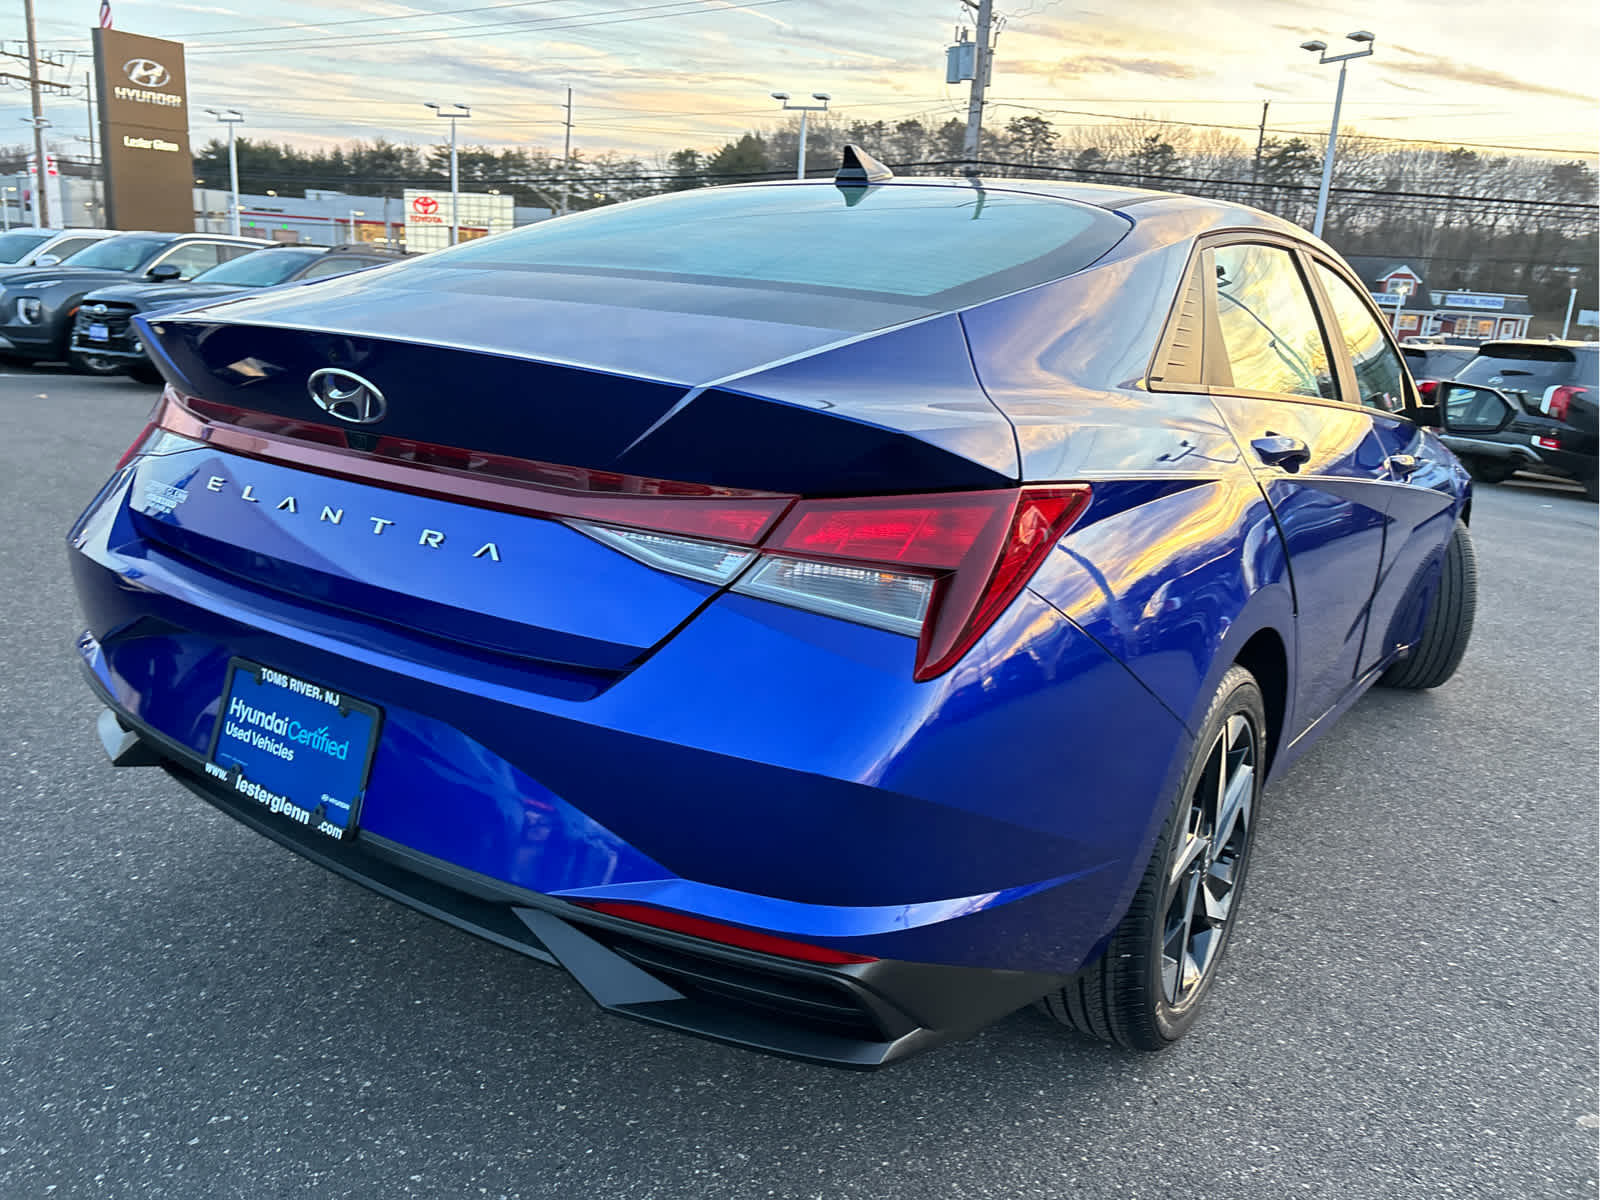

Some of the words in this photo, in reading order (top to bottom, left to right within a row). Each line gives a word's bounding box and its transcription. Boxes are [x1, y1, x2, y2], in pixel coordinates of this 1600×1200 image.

[114, 87, 182, 107] HYUNDAI
[409, 215, 443, 224] TOYOTA
[206, 476, 501, 561] ELANTRA
[261, 668, 288, 688] TOMS
[289, 678, 324, 701] RIVER,
[324, 690, 340, 707] NJ
[225, 721, 251, 743] Used
[252, 731, 295, 761] Vehicles
[229, 697, 289, 736] Hyundai
[287, 721, 349, 760] Certified
[234, 774, 310, 825] lesterglenn
[317, 821, 344, 840] .com
